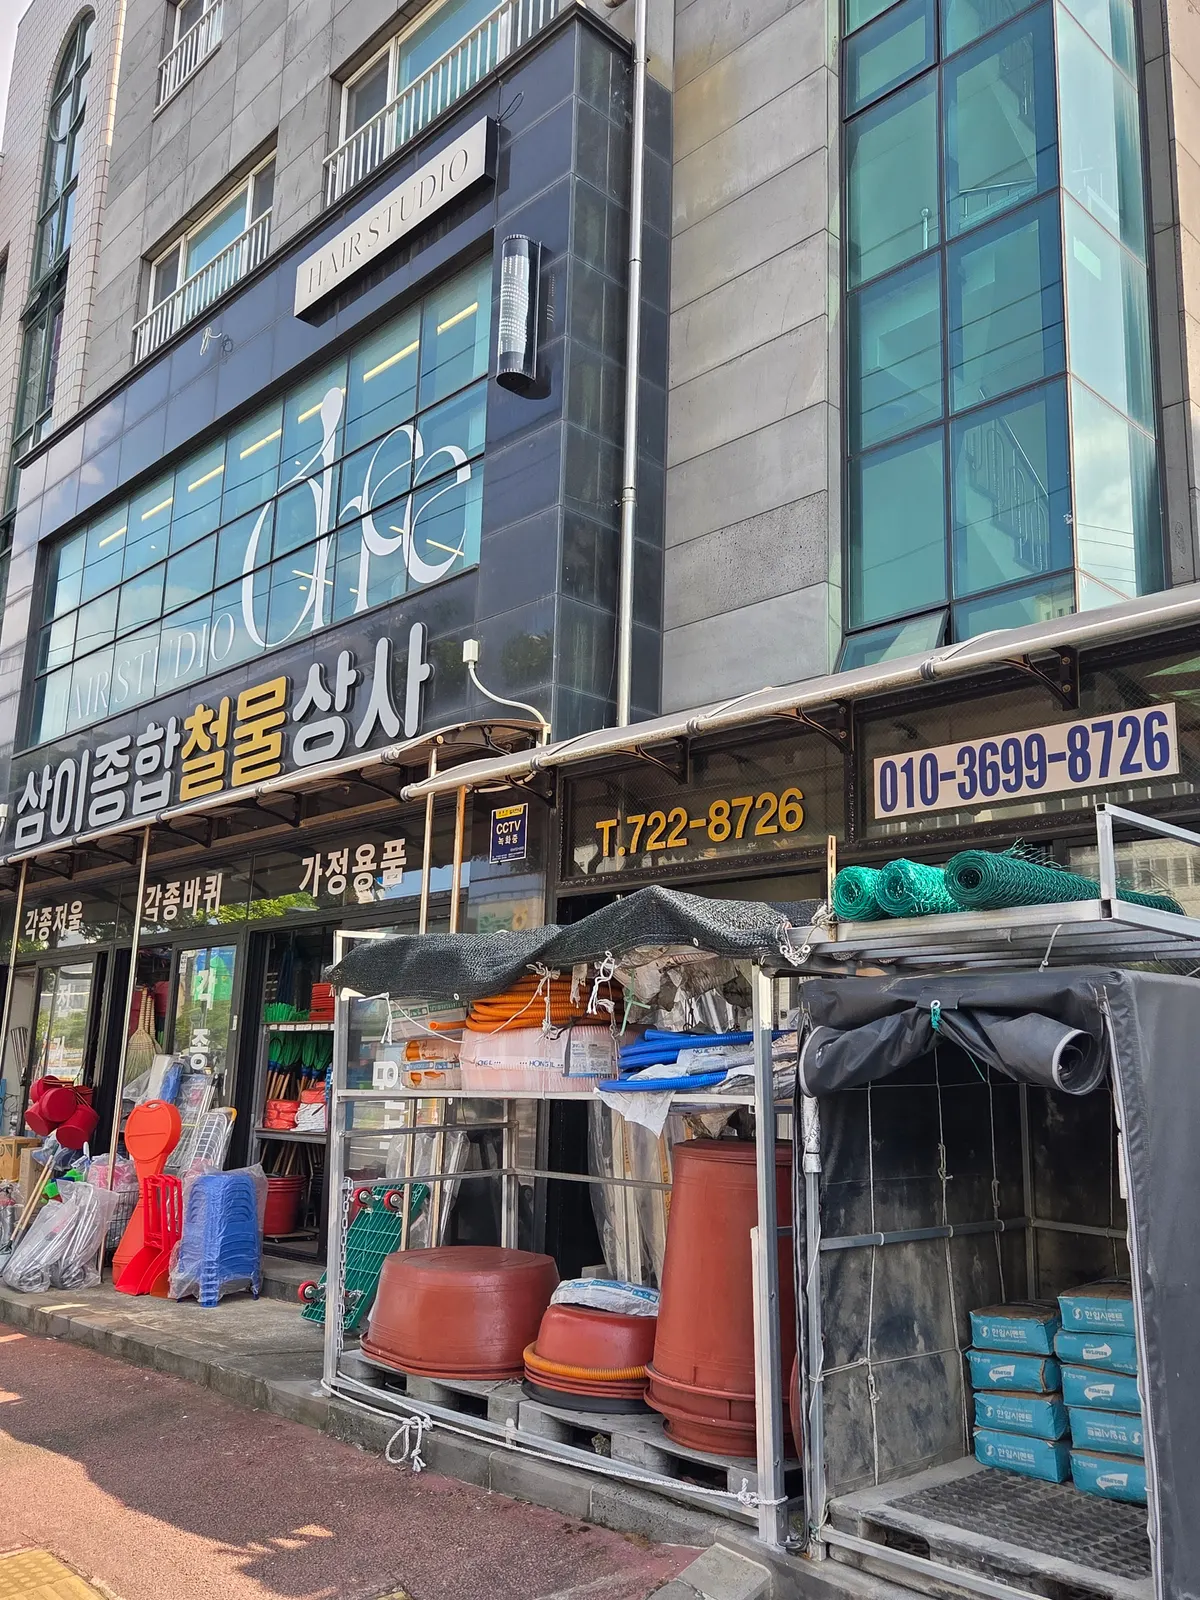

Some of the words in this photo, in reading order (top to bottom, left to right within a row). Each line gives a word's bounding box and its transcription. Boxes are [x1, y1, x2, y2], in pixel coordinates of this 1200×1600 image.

[308, 232, 361, 293] HAIR
[367, 149, 468, 248] STUDIO
[109, 612, 235, 704] STUDIO
[878, 710, 1171, 813] 010-3699-8726
[496, 819, 522, 835] CCTV
[595, 787, 804, 858] T.722-8726
[143, 872, 223, 923] 각종바퀴
[299, 837, 408, 898] 가정용품
[25, 899, 83, 943] 각종저울
